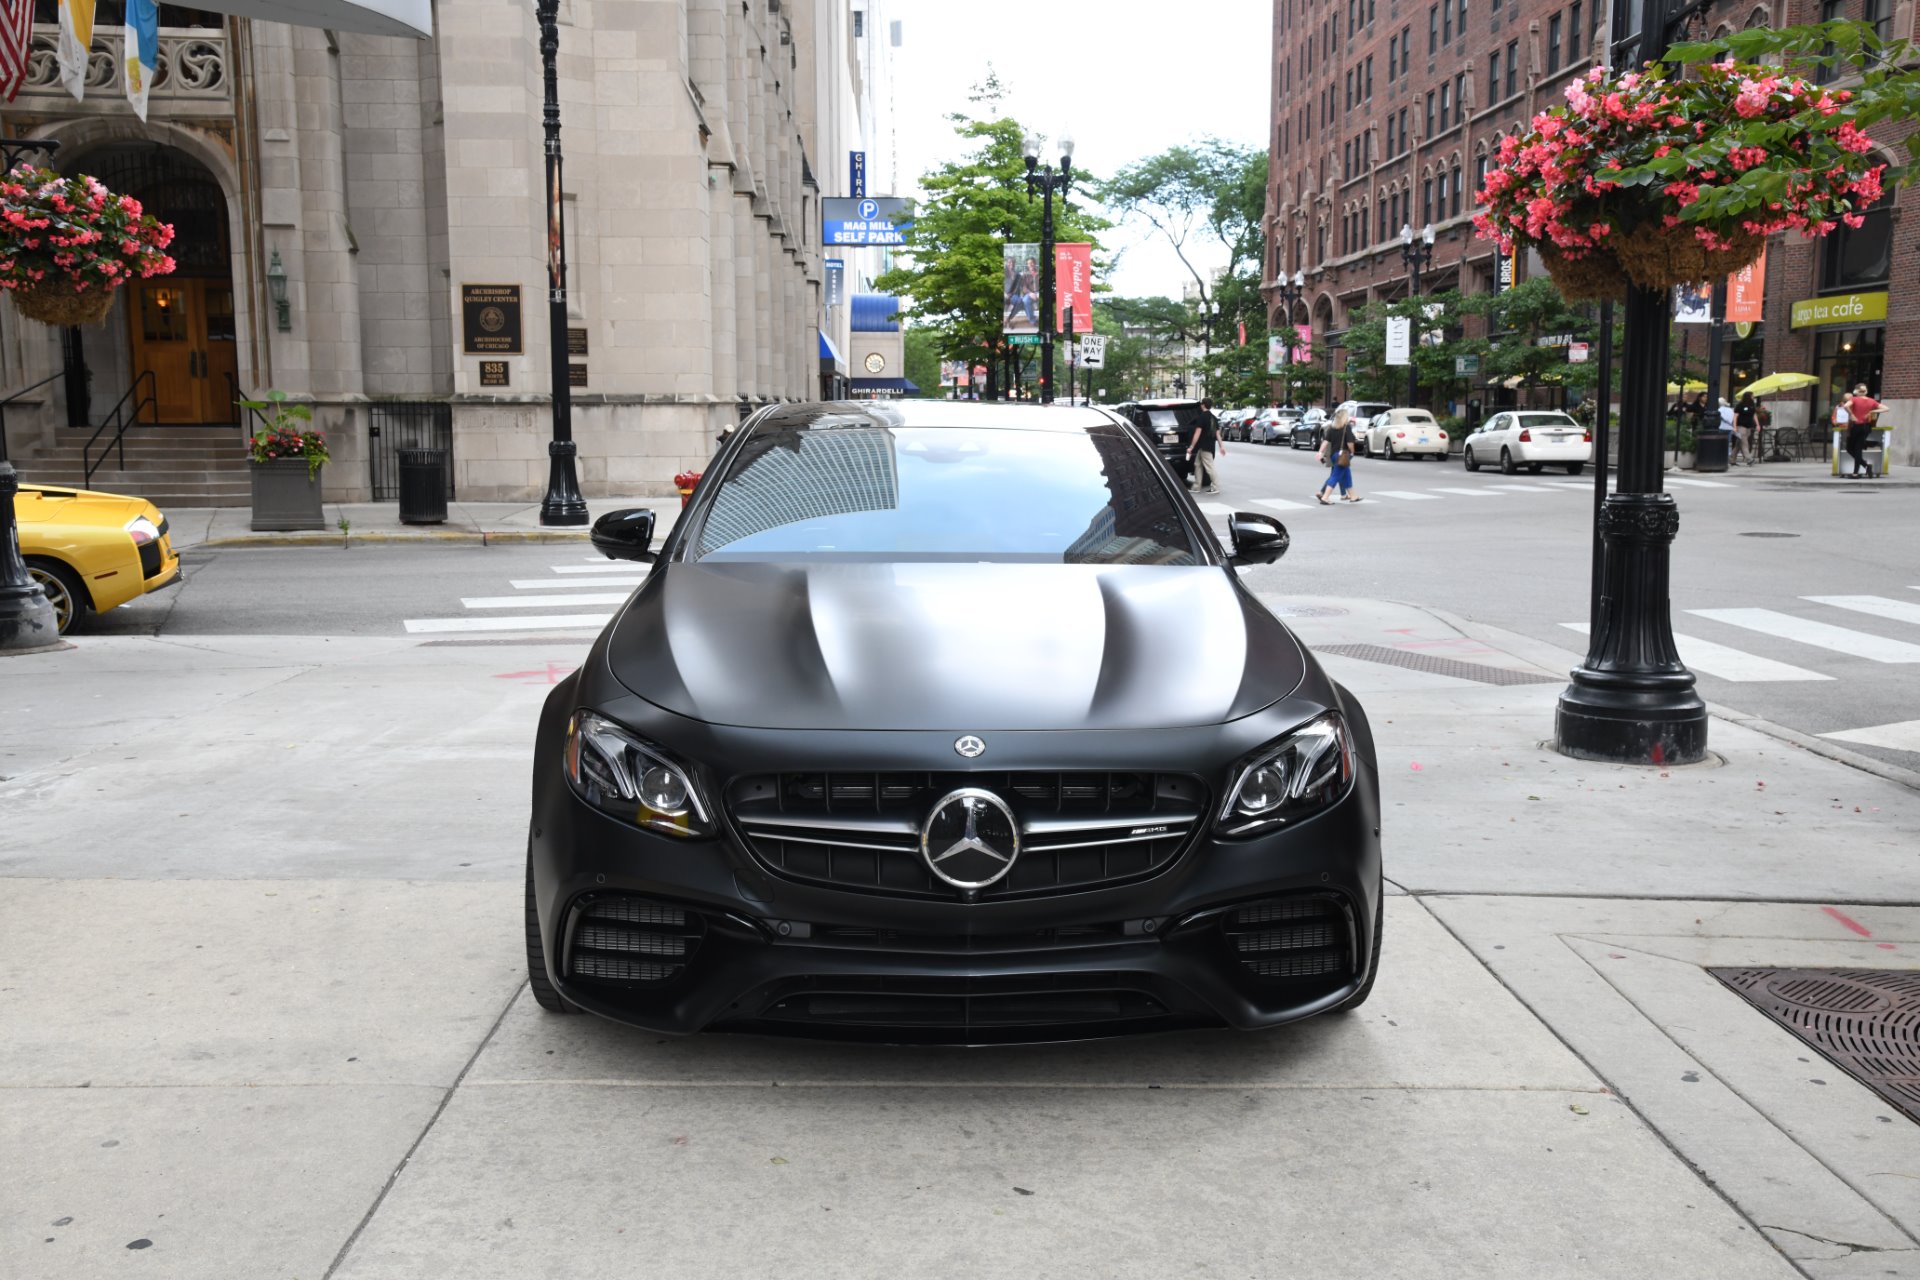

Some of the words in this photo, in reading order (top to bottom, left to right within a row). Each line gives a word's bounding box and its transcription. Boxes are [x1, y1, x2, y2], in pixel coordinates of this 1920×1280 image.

[855, 153, 863, 197] GHIRA
[843, 221, 867, 231] MAG
[869, 221, 895, 231] MILE
[834, 231, 866, 243] SELF
[868, 231, 904, 243] PARK
[1072, 260, 1083, 293] Folded
[1062, 291, 1073, 310] Ma
[1814, 305, 1828, 319] tea
[1831, 295, 1864, 317] café
[1015, 335, 1033, 343] RUSH
[1084, 337, 1102, 346] ONE
[1083, 347, 1102, 356] WAY
[484, 362, 504, 373] 835
